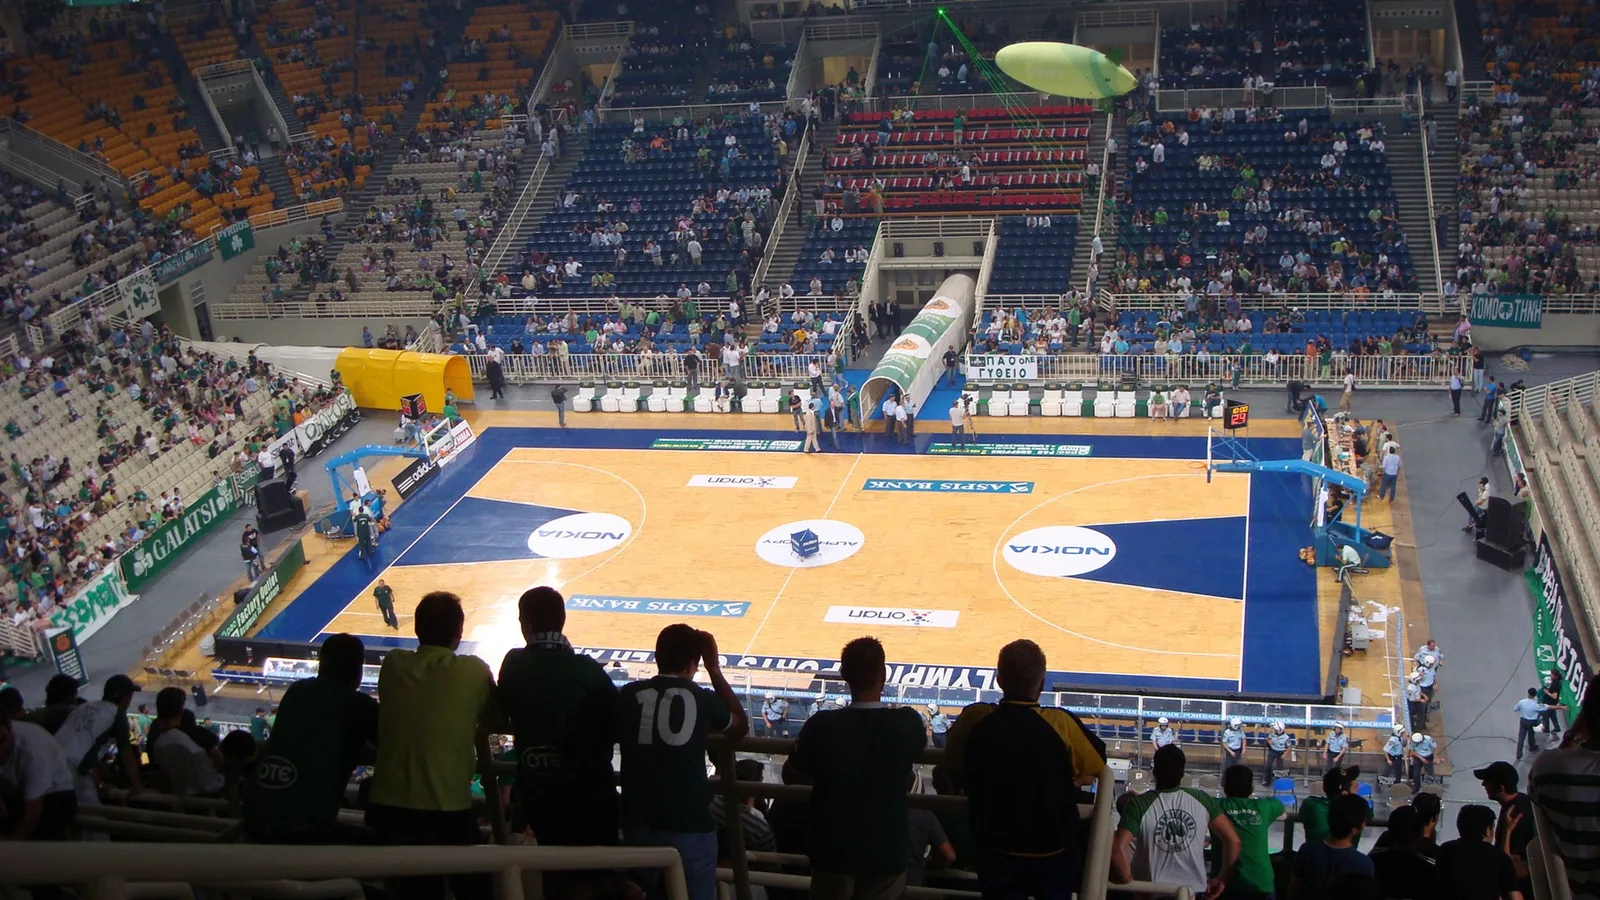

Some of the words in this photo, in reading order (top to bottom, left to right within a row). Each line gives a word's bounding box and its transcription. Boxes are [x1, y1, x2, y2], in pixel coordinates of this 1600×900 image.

[217, 219, 250, 240] PYRGOS
[979, 368, 1027, 378] ΓΥΘΕΙΟ
[1231, 413, 1246, 425] 24
[413, 461, 437, 481] adid
[869, 479, 933, 490] BANK
[940, 481, 1008, 492] ASPIS
[152, 498, 217, 561] GALATSI
[538, 529, 624, 541] NOKIA
[763, 538, 858, 548] ALPHOPY
[1008, 543, 1110, 556] NOKIA
[236, 593, 261, 628] Factory
[260, 571, 279, 600] Outlet
[572, 597, 641, 611] BANK
[647, 600, 720, 615] ASPIS
[884, 664, 1002, 692] LYMPI
[902, 697, 937, 705] POWERADE
[636, 687, 698, 746] 10
[1353, 721, 1392, 729] POWERADE
